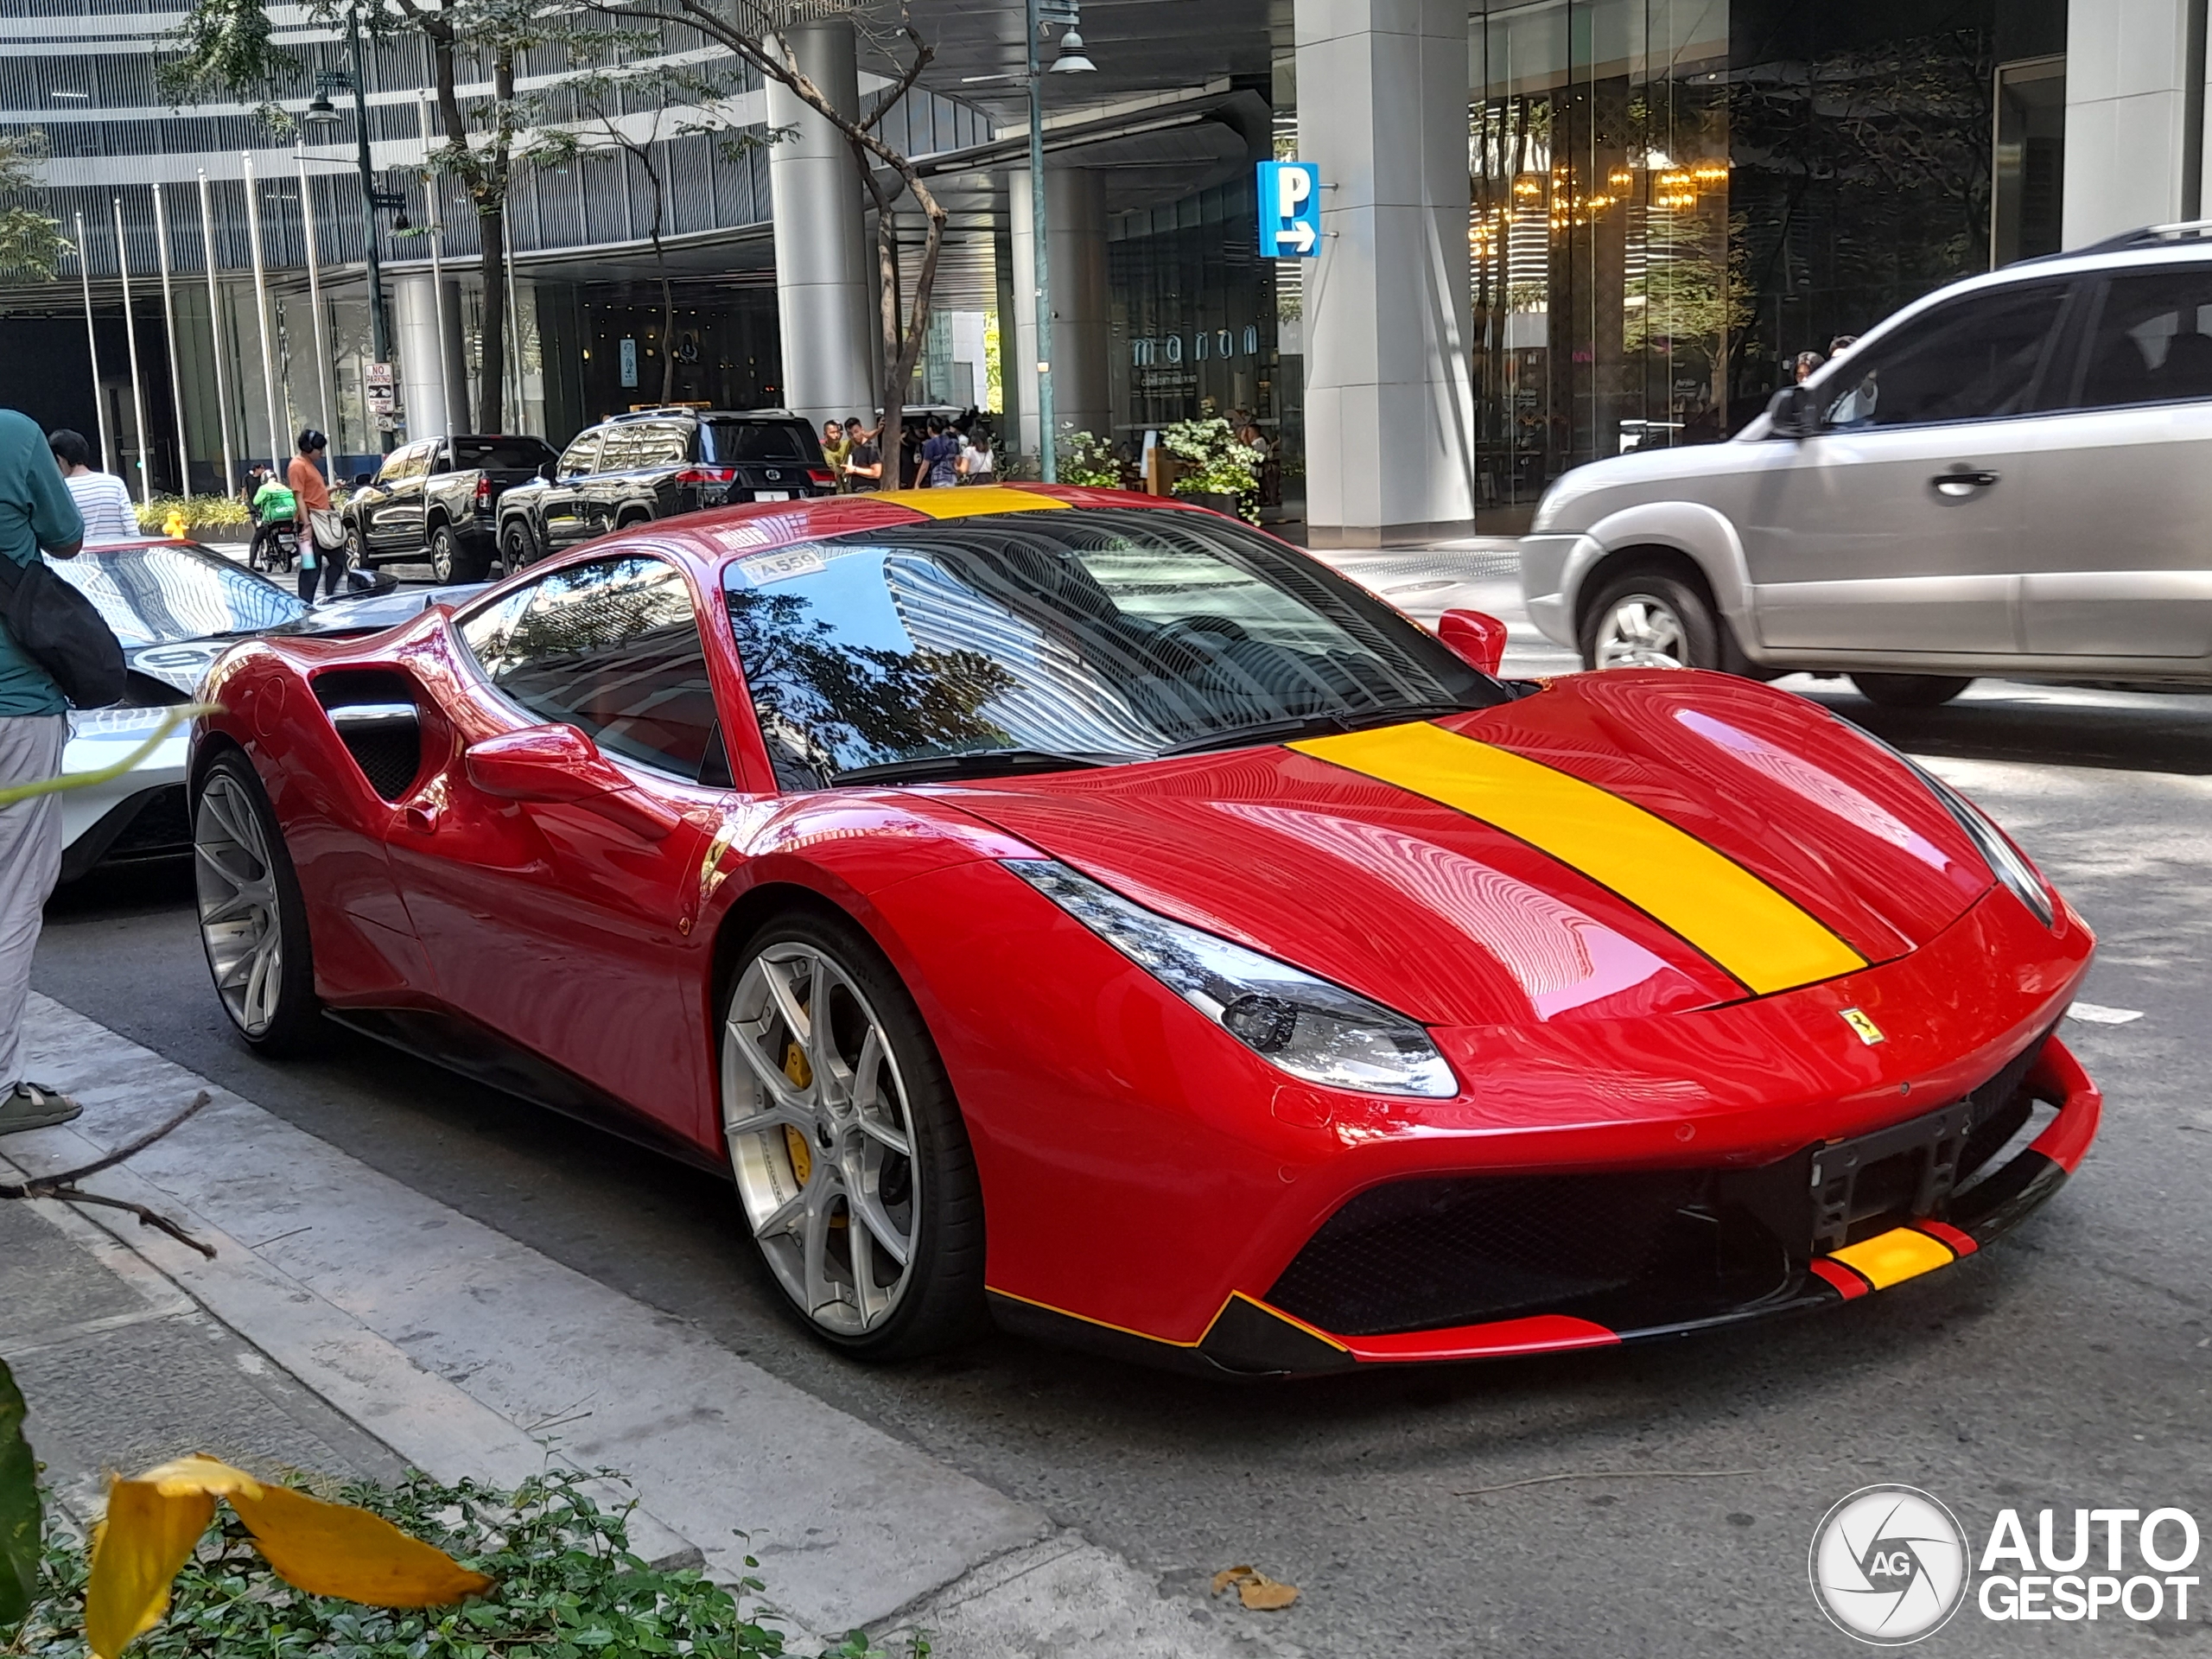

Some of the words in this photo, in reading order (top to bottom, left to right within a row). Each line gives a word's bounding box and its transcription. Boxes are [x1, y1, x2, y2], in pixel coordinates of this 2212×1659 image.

[1278, 167, 1312, 218] P
[372, 365, 385, 375] NO
[366, 375, 391, 384] PARKING
